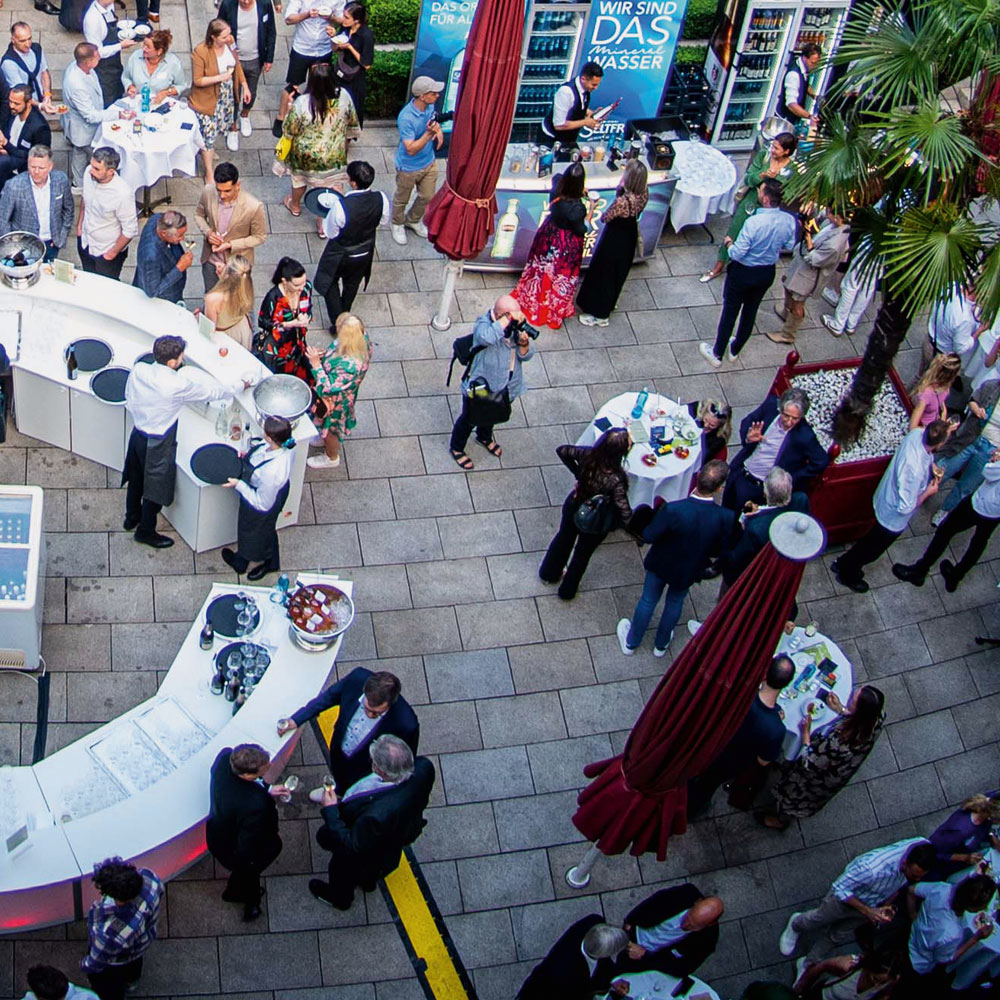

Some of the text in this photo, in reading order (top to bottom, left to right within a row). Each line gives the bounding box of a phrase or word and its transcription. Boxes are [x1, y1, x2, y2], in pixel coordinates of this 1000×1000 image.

[431, 1, 457, 12] DAS
[600, 1, 677, 15] WIR SIND
[429, 12, 455, 25] FÜR
[590, 15, 673, 45] DAS
[587, 55, 664, 70] WASSER
